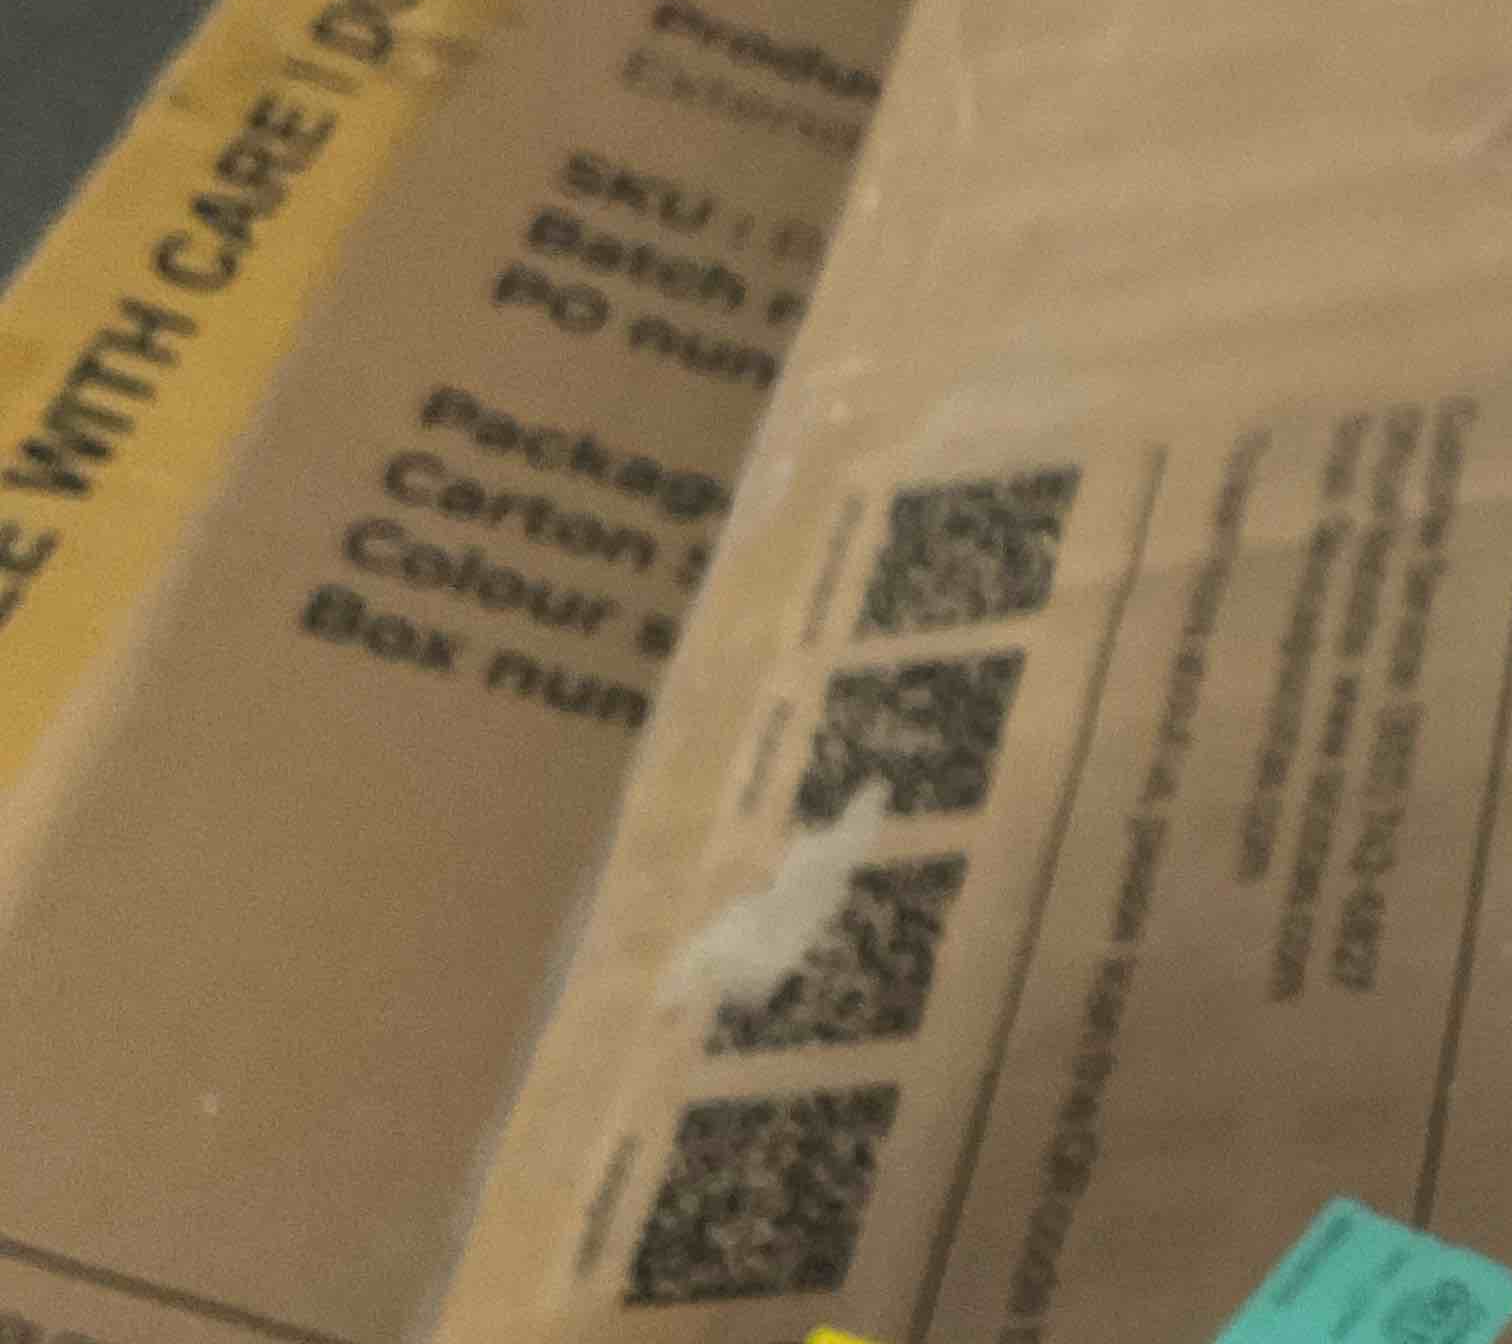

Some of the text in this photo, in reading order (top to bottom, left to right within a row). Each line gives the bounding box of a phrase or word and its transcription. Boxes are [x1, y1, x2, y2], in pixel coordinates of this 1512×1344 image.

[1, 296, 199, 498] WITH
[151, 94, 337, 293] CARE
[496, 264, 609, 332] PO
[529, 207, 746, 308] Batch
[384, 452, 655, 570] Carton
[303, 584, 460, 669] Box
[344, 518, 614, 631] Colour
